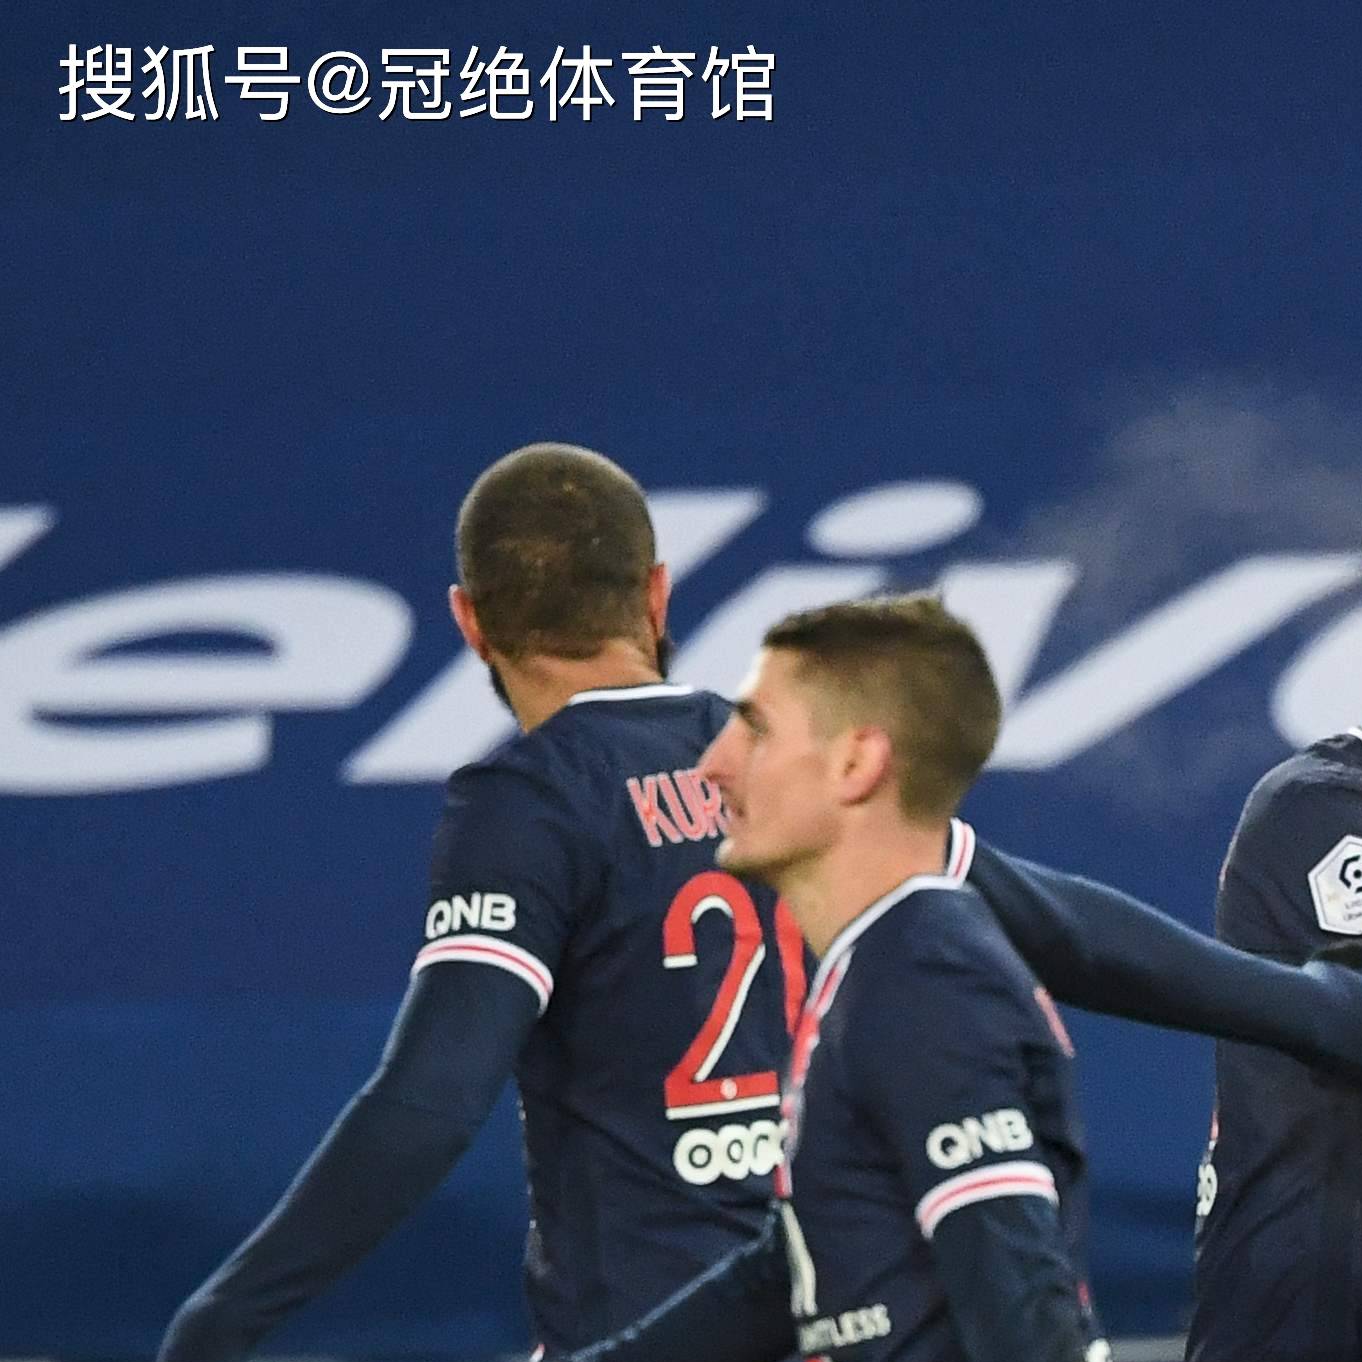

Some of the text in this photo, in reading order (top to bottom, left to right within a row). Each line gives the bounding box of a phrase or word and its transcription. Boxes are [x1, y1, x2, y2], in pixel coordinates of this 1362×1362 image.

[626, 768, 732, 848] KUR
[663, 870, 806, 1121] 2
[926, 1108, 1034, 1170] QNB
